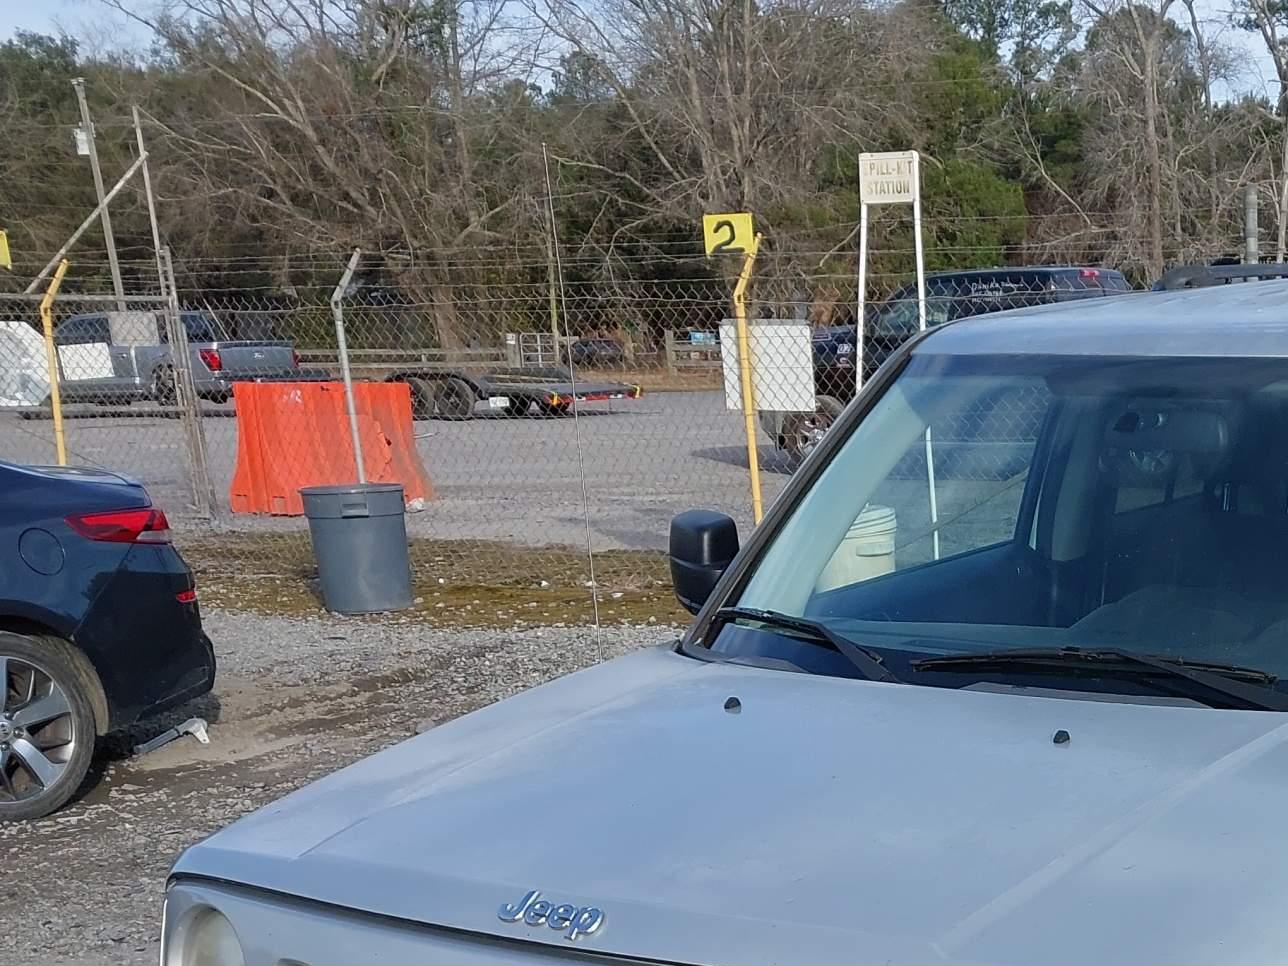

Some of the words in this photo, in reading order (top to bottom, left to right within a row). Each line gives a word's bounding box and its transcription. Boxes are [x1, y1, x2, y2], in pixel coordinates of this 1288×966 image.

[867, 179, 910, 195] STATION
[710, 219, 746, 254] 2
[498, 889, 604, 941] Jeep
